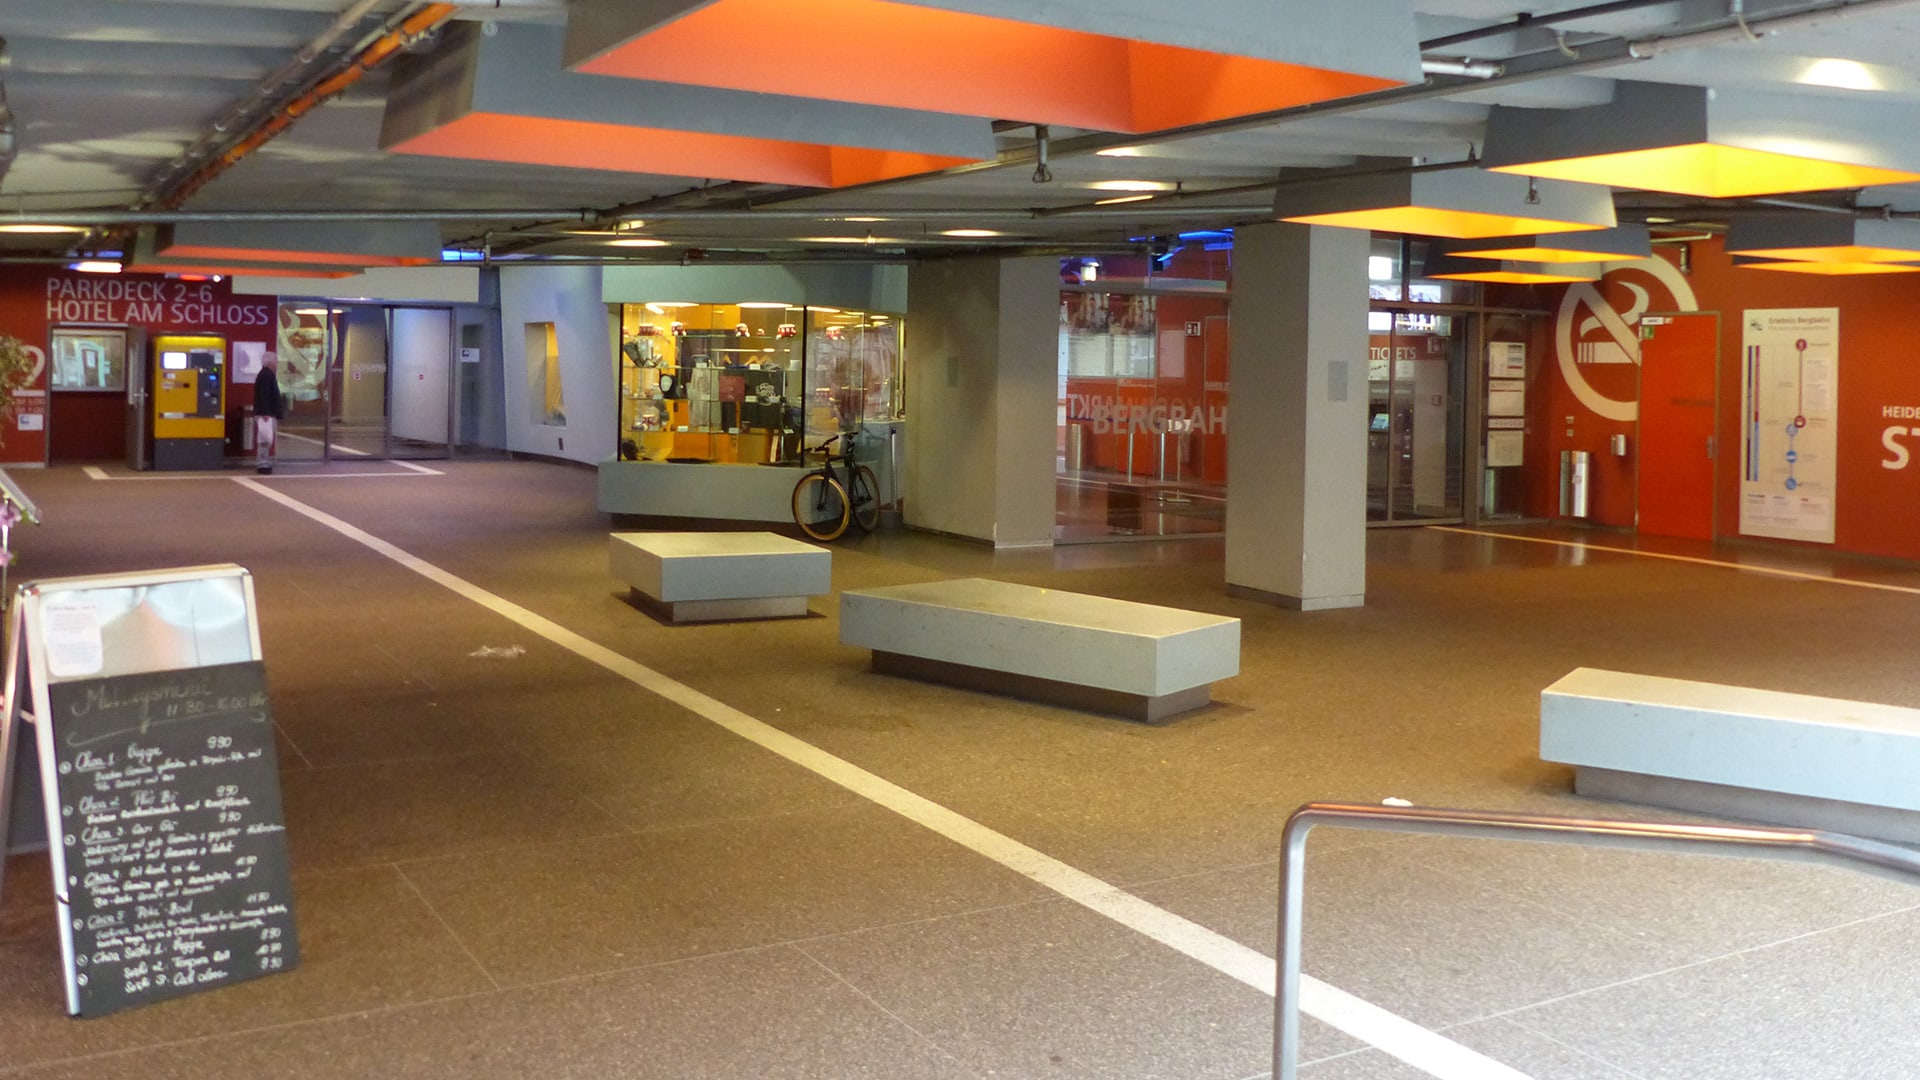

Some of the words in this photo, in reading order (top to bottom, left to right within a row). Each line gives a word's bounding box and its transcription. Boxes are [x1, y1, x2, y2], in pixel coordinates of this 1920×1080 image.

[47, 279, 166, 302] PARKDECK
[47, 300, 118, 322] HOTEL
[125, 303, 162, 323] AM
[171, 303, 269, 325] SCHLOSS
[1370, 346, 1417, 361] TICETS
[1882, 405, 1920, 419] HEIDE
